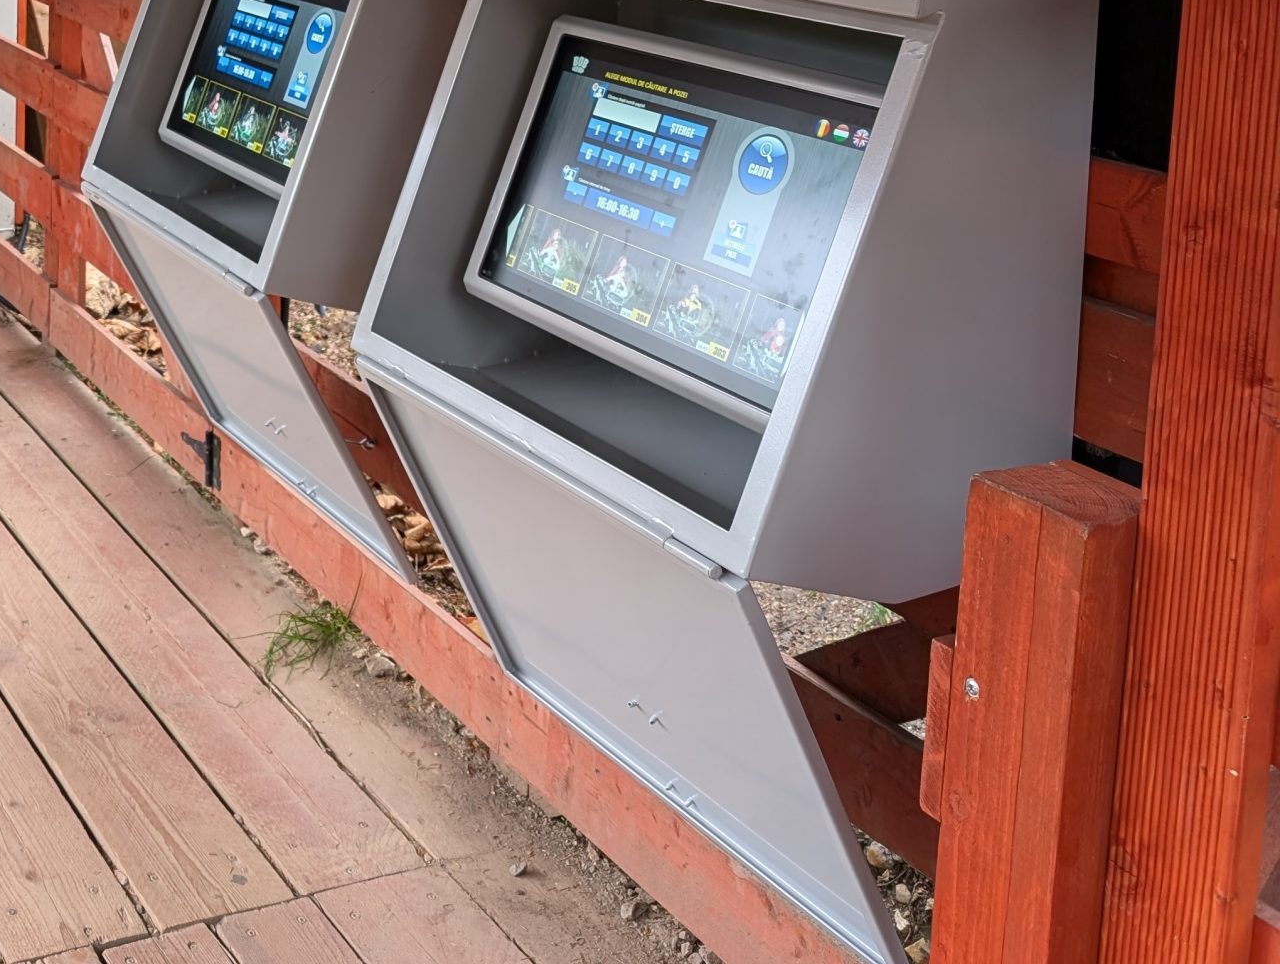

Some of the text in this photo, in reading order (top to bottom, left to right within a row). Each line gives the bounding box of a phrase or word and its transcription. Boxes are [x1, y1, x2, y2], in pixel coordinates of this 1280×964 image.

[604, 71, 620, 82] ALEGE
[620, 75, 637, 86] MODUL
[638, 80, 645, 88] DE
[645, 81, 668, 94] CĂUTARE
[594, 124, 690, 164] 1 2 3 4 5
[585, 148, 680, 190] 6 7 8 9 0
[748, 162, 774, 180] CAUTĂ
[596, 196, 640, 221] 16:00-16:30
[636, 311, 648, 324] 304
[712, 344, 726, 358] 303
